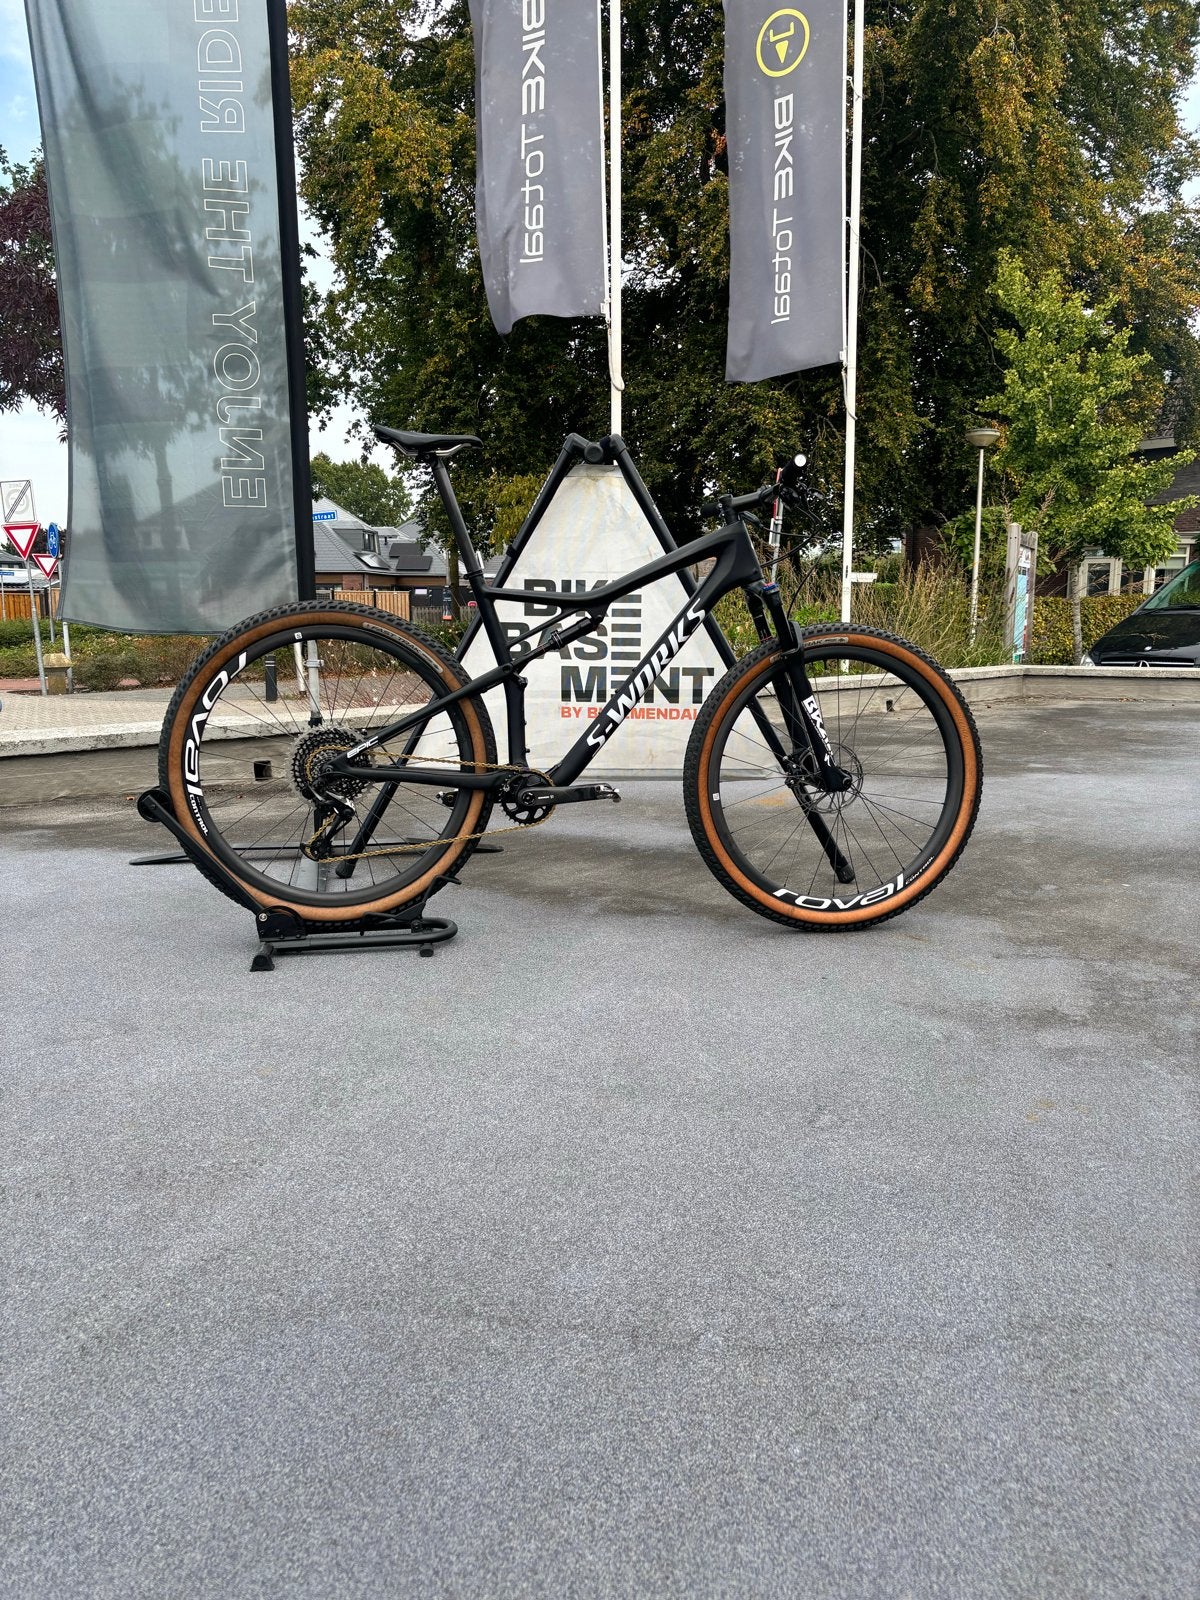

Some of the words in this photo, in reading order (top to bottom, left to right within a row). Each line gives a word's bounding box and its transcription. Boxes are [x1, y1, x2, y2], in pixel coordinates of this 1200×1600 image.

[586, 598, 706, 757] S-WORKS
[561, 706, 582, 718] BY
[347, 735, 379, 759] EPIC
[772, 873, 904, 910] roval
